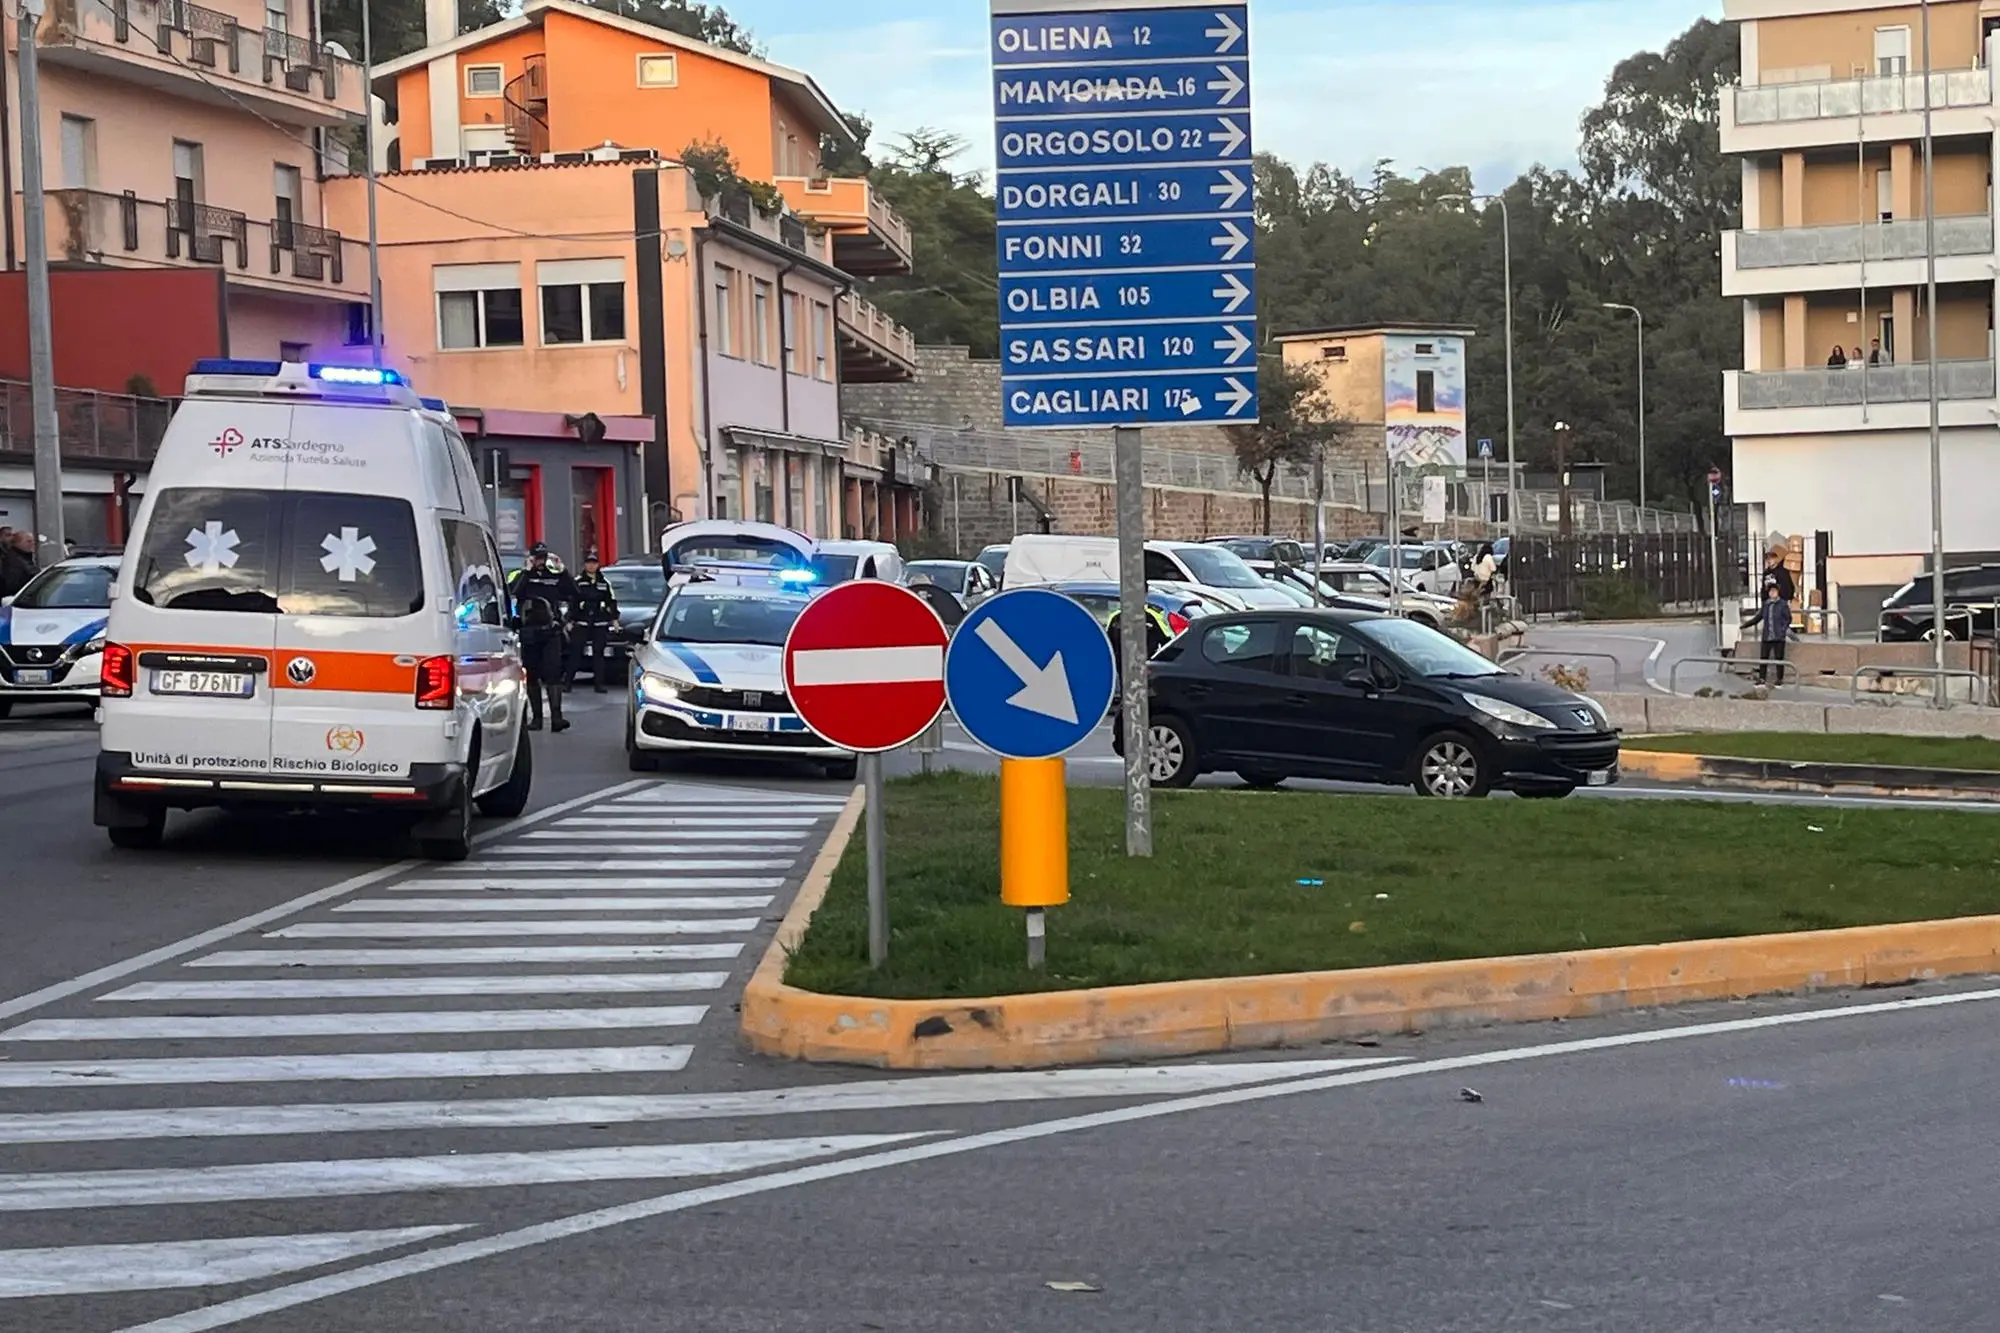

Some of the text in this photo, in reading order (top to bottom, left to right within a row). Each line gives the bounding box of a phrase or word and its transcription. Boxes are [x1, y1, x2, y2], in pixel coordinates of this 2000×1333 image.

[998, 26, 1151, 52] OLIENA 12
[1000, 77, 1196, 104] MAMOIADA 16
[1002, 127, 1202, 157] ORGOSOLO 22
[1003, 181, 1181, 209] DORGALI 30
[1005, 234, 1142, 261] FONNI 32
[1007, 287, 1150, 312] OLBIA 105
[1009, 336, 1194, 364] SASSARI 120
[1011, 388, 1149, 415] CAGLIARI
[296, 454, 330, 466] Tutela
[333, 455, 367, 468] Salute
[162, 672, 183, 690] GF
[135, 751, 399, 774] Unità di protezione Rischio Biologico
